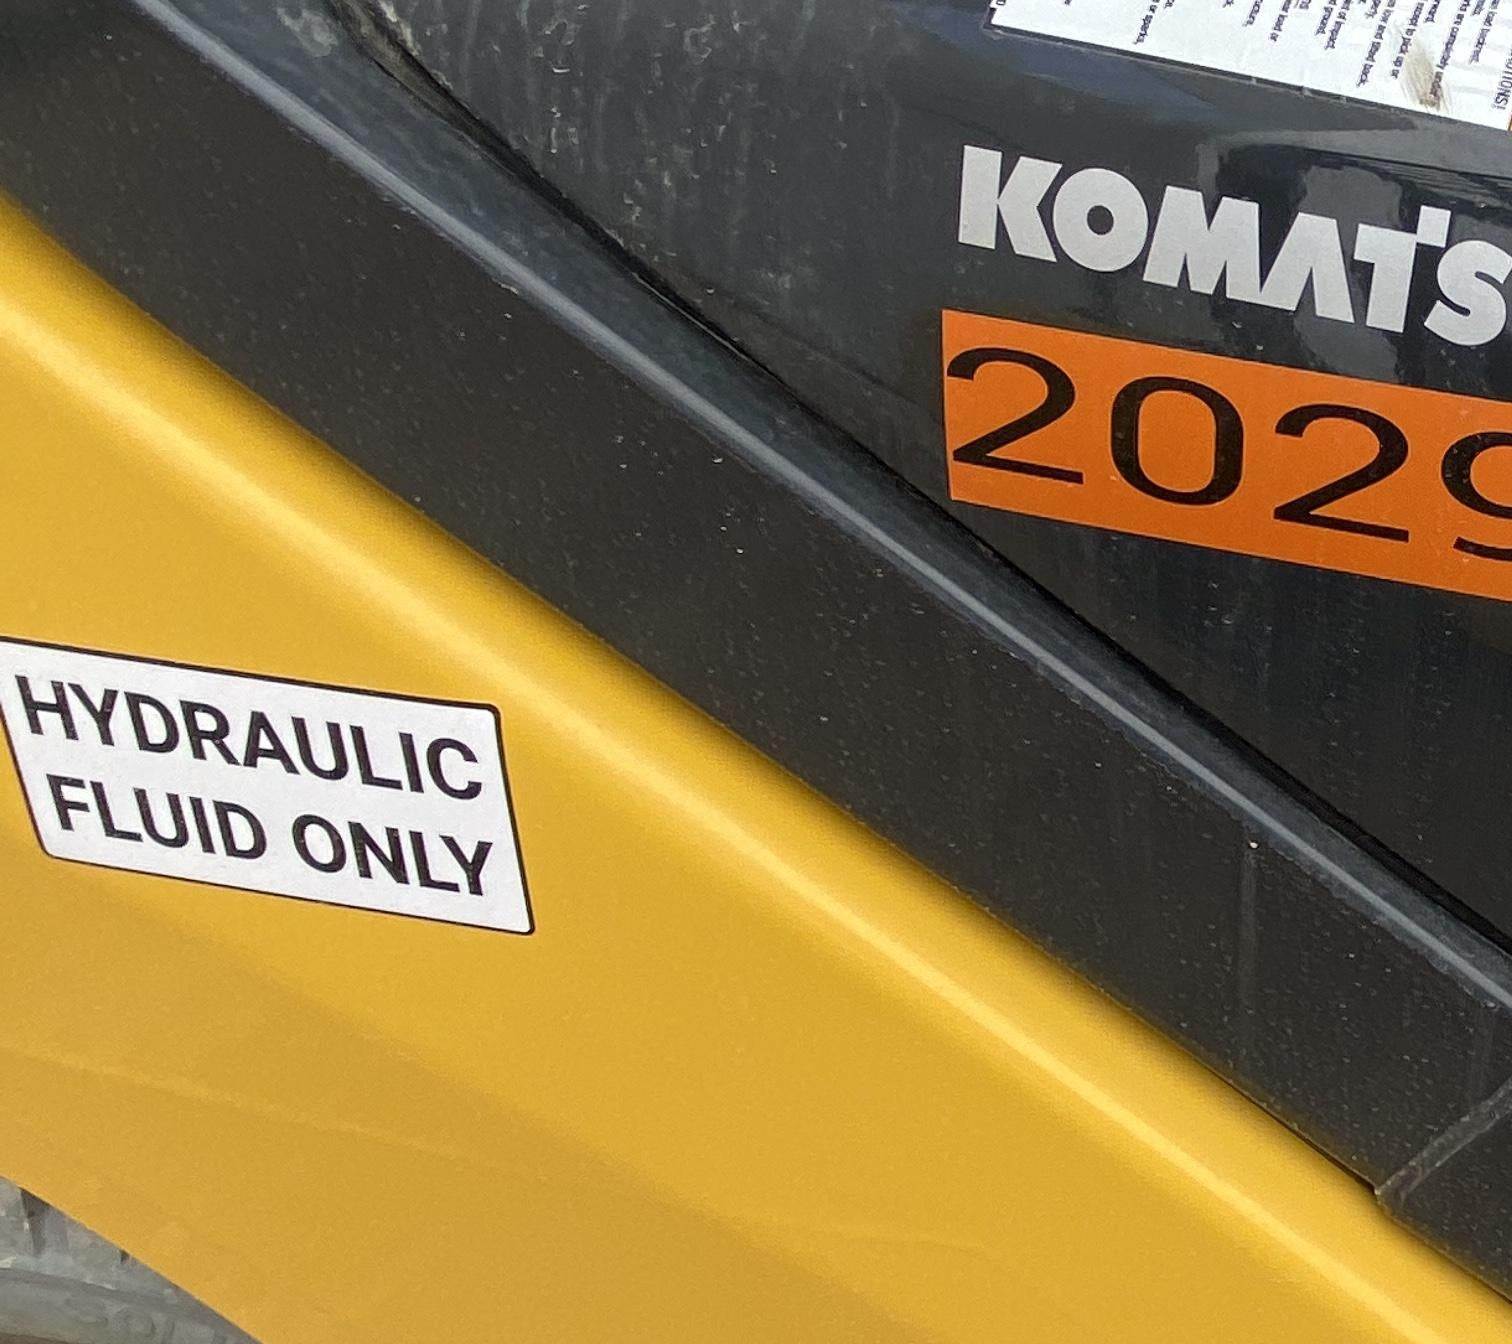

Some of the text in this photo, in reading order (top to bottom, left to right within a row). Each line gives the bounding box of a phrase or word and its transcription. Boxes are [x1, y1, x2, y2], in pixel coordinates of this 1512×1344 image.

[15, 675, 483, 801] HYDRAULIC
[46, 773, 493, 897] FLUID ONLY
